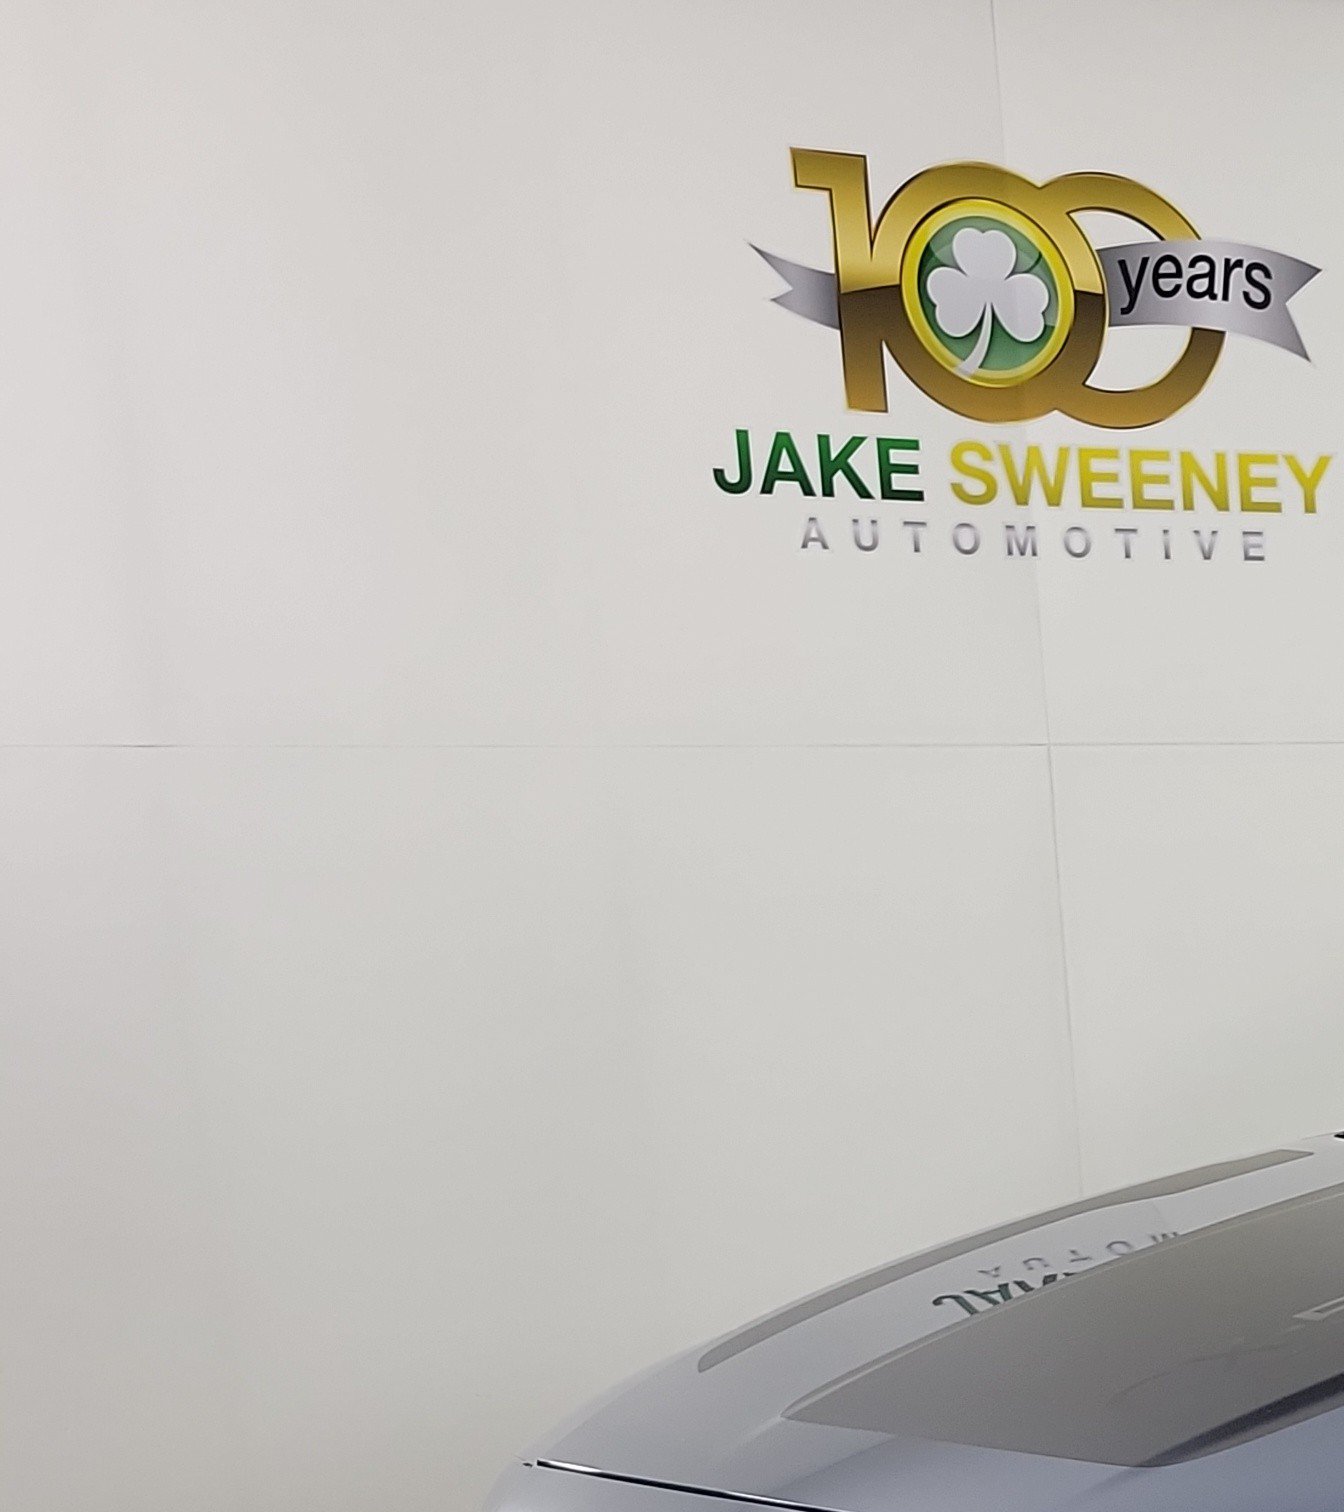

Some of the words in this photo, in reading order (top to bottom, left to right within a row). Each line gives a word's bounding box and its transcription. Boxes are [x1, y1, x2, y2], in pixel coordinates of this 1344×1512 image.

[789, 146, 1227, 430] 100
[1116, 251, 1273, 316] years
[712, 428, 926, 502] JAKE
[948, 440, 1333, 514] SWEENEY
[799, 516, 1267, 562] AUTOMOTIVE
